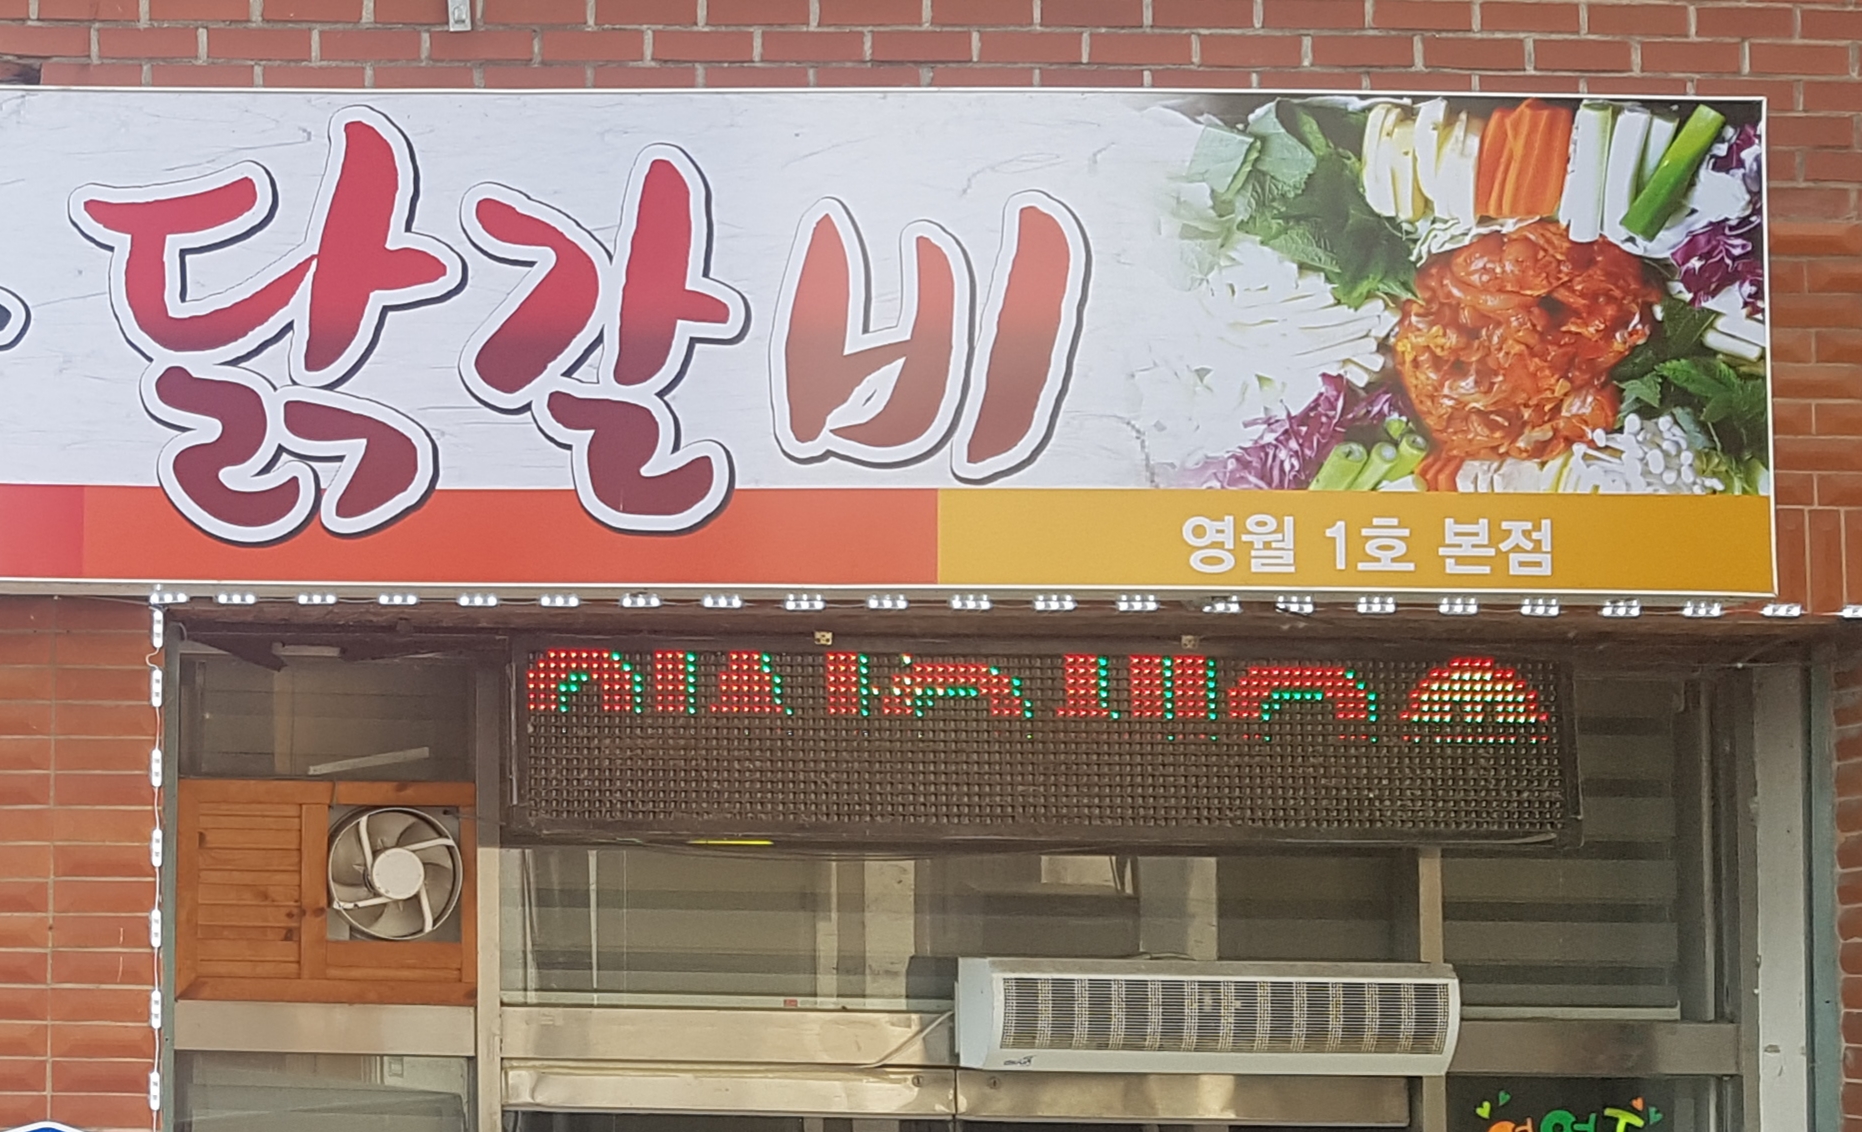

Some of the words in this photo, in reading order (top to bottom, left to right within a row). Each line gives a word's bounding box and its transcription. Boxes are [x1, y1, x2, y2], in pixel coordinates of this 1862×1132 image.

[70, 106, 1091, 543] 닭갈비
[1181, 514, 1296, 574] 영월
[1324, 516, 1415, 573] 1호
[1437, 516, 1553, 576] 본점
